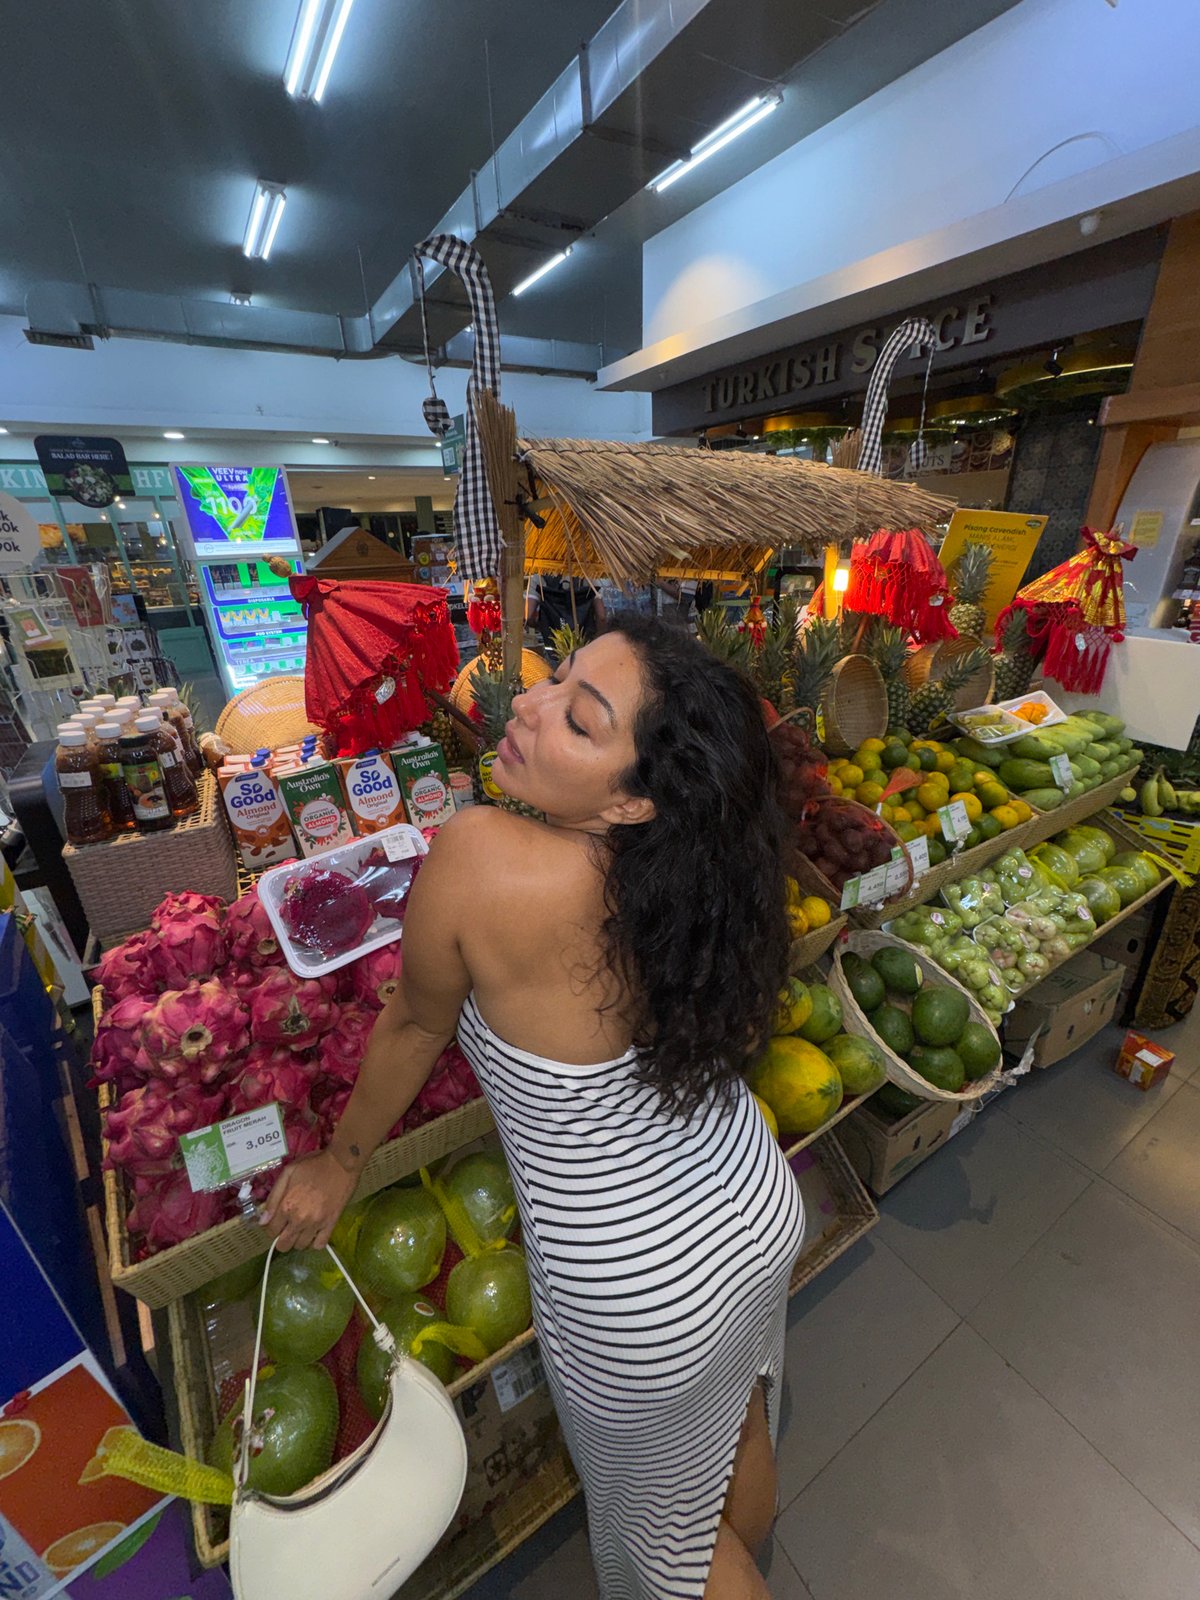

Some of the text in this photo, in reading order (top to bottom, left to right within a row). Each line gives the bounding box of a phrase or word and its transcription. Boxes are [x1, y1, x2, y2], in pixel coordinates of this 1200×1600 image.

[703, 298, 991, 413] TURKISH SCE
[921, 454, 944, 470] UTS
[212, 467, 234, 475] VEEV
[0, 521, 19, 533] 0k
[964, 524, 1027, 536] Pisang Cavendish
[401, 750, 439, 766] Australia's
[411, 760, 431, 769] Own
[286, 772, 330, 790] Australia's
[300, 783, 321, 793] Own
[352, 776, 393, 796] Good
[358, 790, 394, 806] Almond
[414, 785, 441, 796] ORGANIC
[416, 792, 442, 803] ALMOND
[230, 789, 276, 809] Good
[236, 802, 277, 818] Almond
[303, 808, 336, 822] ORGANIC
[306, 816, 336, 829] ALMOND
[221, 1116, 251, 1130] DRAGON
[223, 1124, 242, 1135] FRUIT
[243, 1116, 267, 1128] MERAH
[245, 1130, 280, 1150] 3,050
